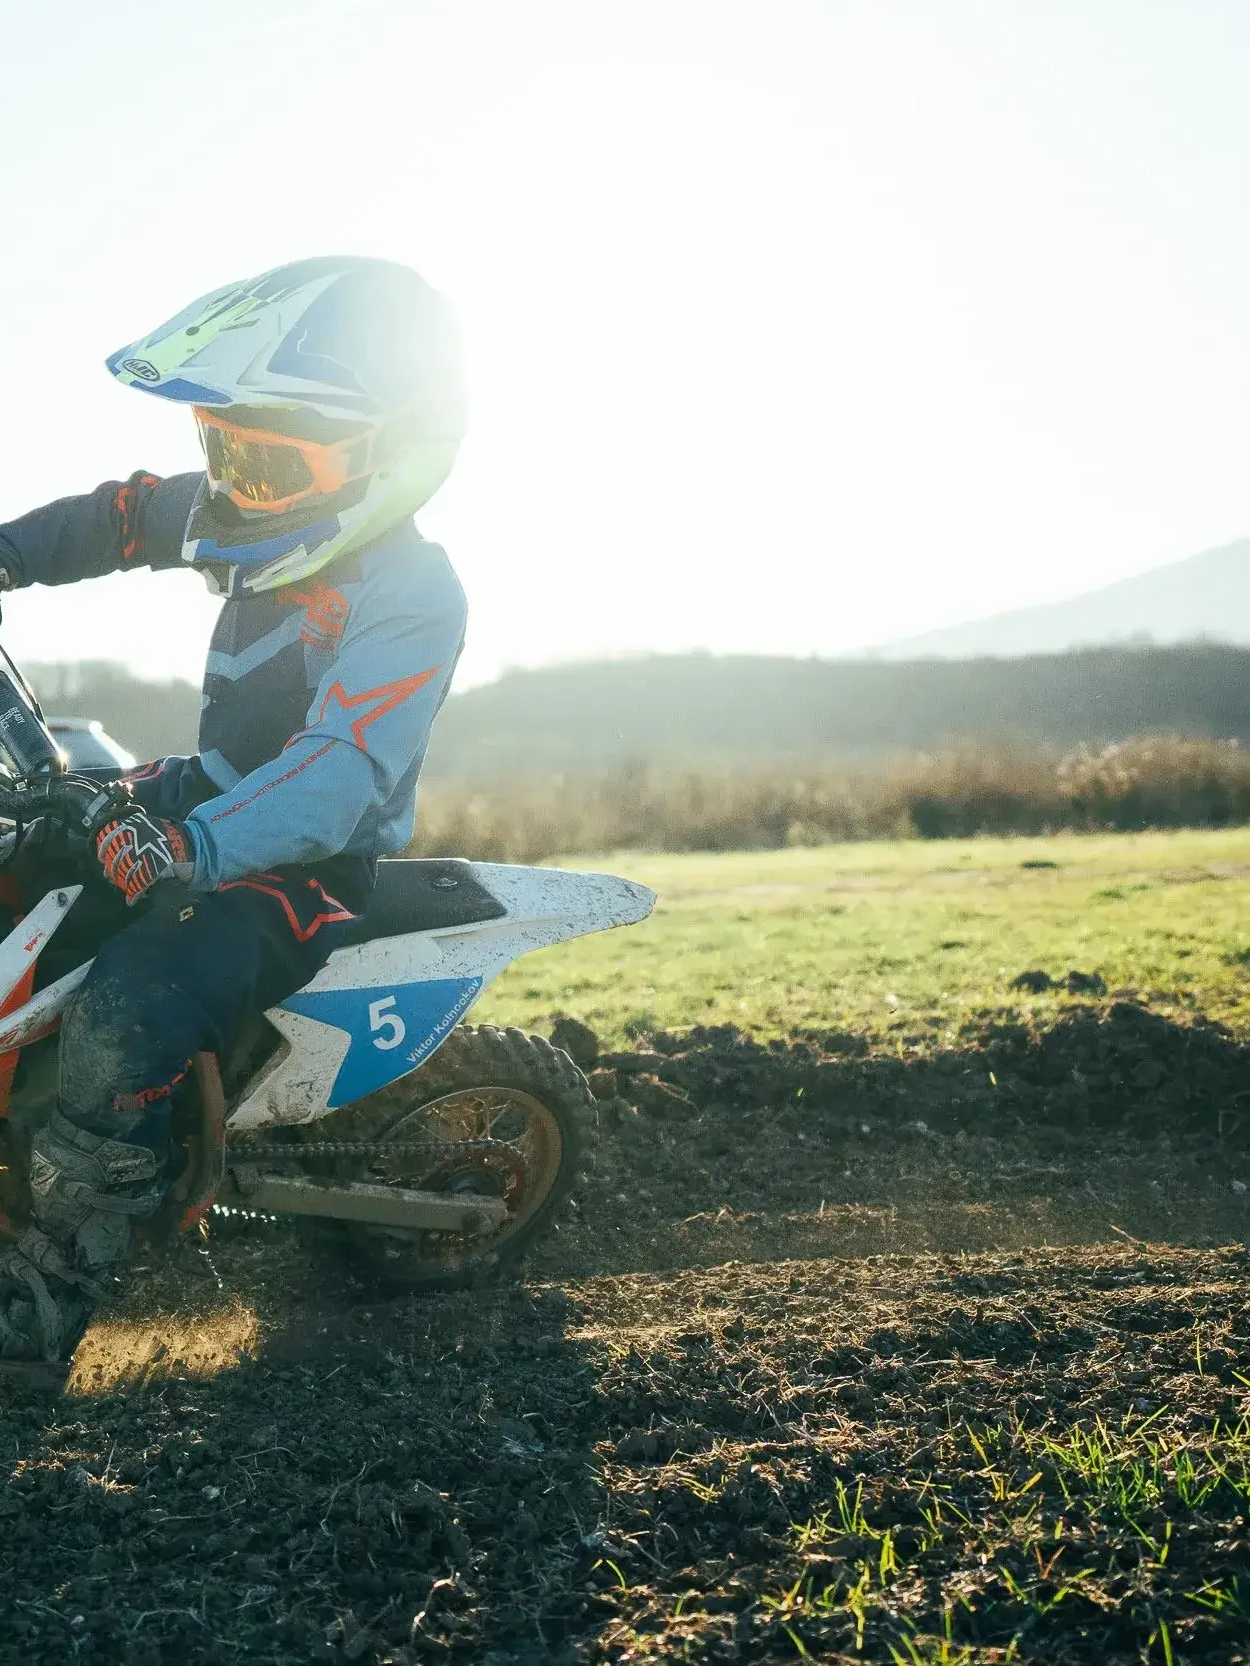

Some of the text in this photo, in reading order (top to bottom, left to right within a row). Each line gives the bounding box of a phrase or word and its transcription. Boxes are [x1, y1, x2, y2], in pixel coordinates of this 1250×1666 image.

[125, 360, 157, 378] HJC
[9, 706, 26, 724] READY
[368, 994, 406, 1050] 5
[406, 1033, 437, 1064] Viktor
